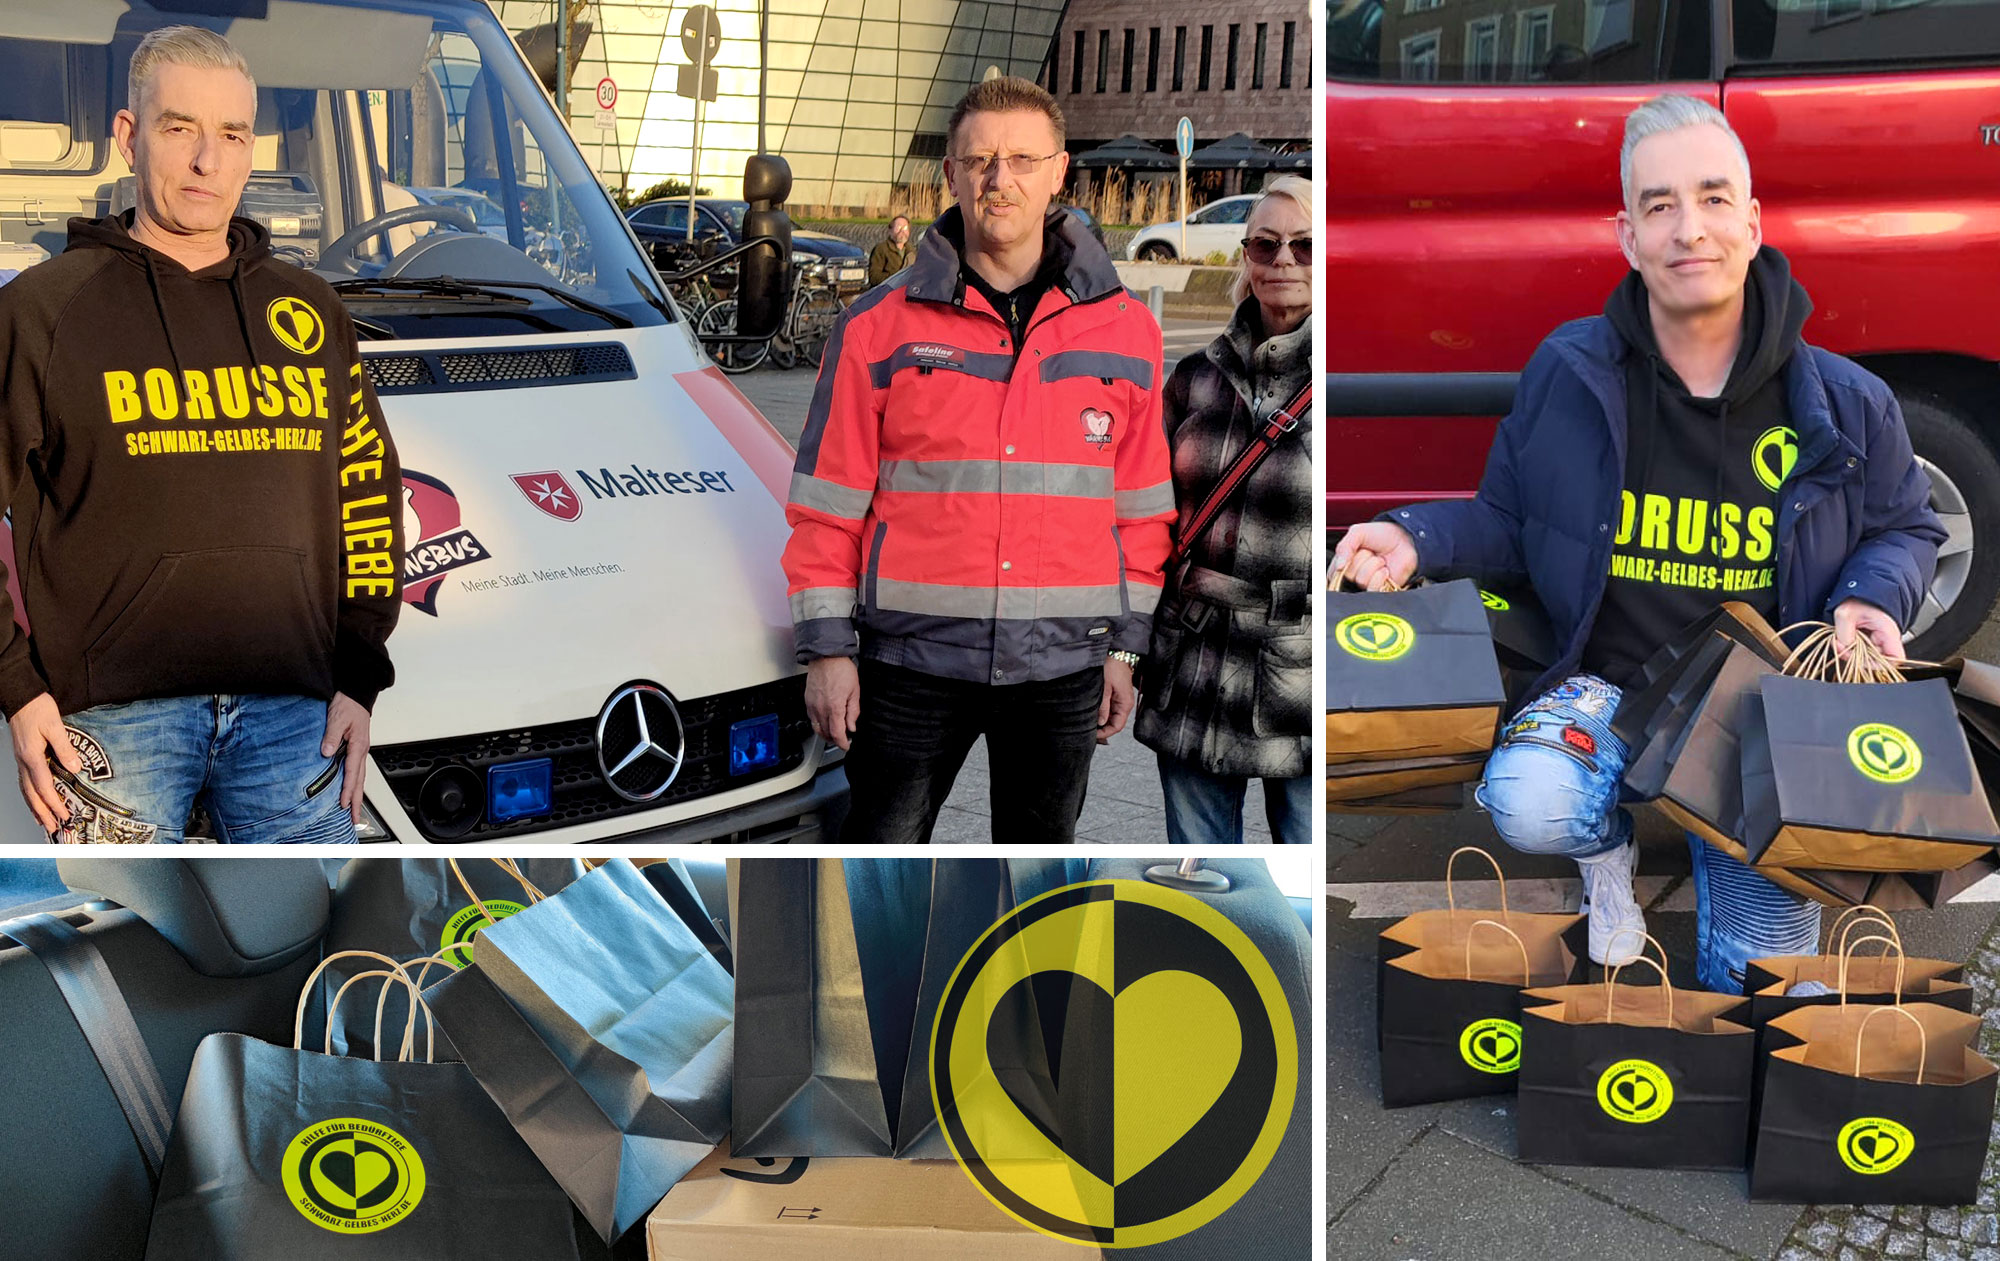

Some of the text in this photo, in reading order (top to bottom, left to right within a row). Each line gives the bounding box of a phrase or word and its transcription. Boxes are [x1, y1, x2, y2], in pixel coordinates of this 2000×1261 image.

[601, 86, 613, 101] 30
[104, 366, 329, 424] BORUSSE
[126, 428, 323, 456] SCHWARZ-GELBES-HERZ.DE
[576, 464, 736, 499] Malteser
[342, 494, 395, 599] LIEBE
[403, 535, 480, 578] NSBUS
[461, 562, 626, 593] Meine Stadt. Meine Menschen.
[1608, 554, 1774, 591] WARZ-GELBES-HERZ.DE
[79, 738, 89, 751] &
[85, 745, 106, 771] BAXX
[300, 1123, 408, 1152] HILFE FÜR BEDÜRFTIGE
[299, 1197, 412, 1229] SCHWARZ-GELBES-HERZ.DE
